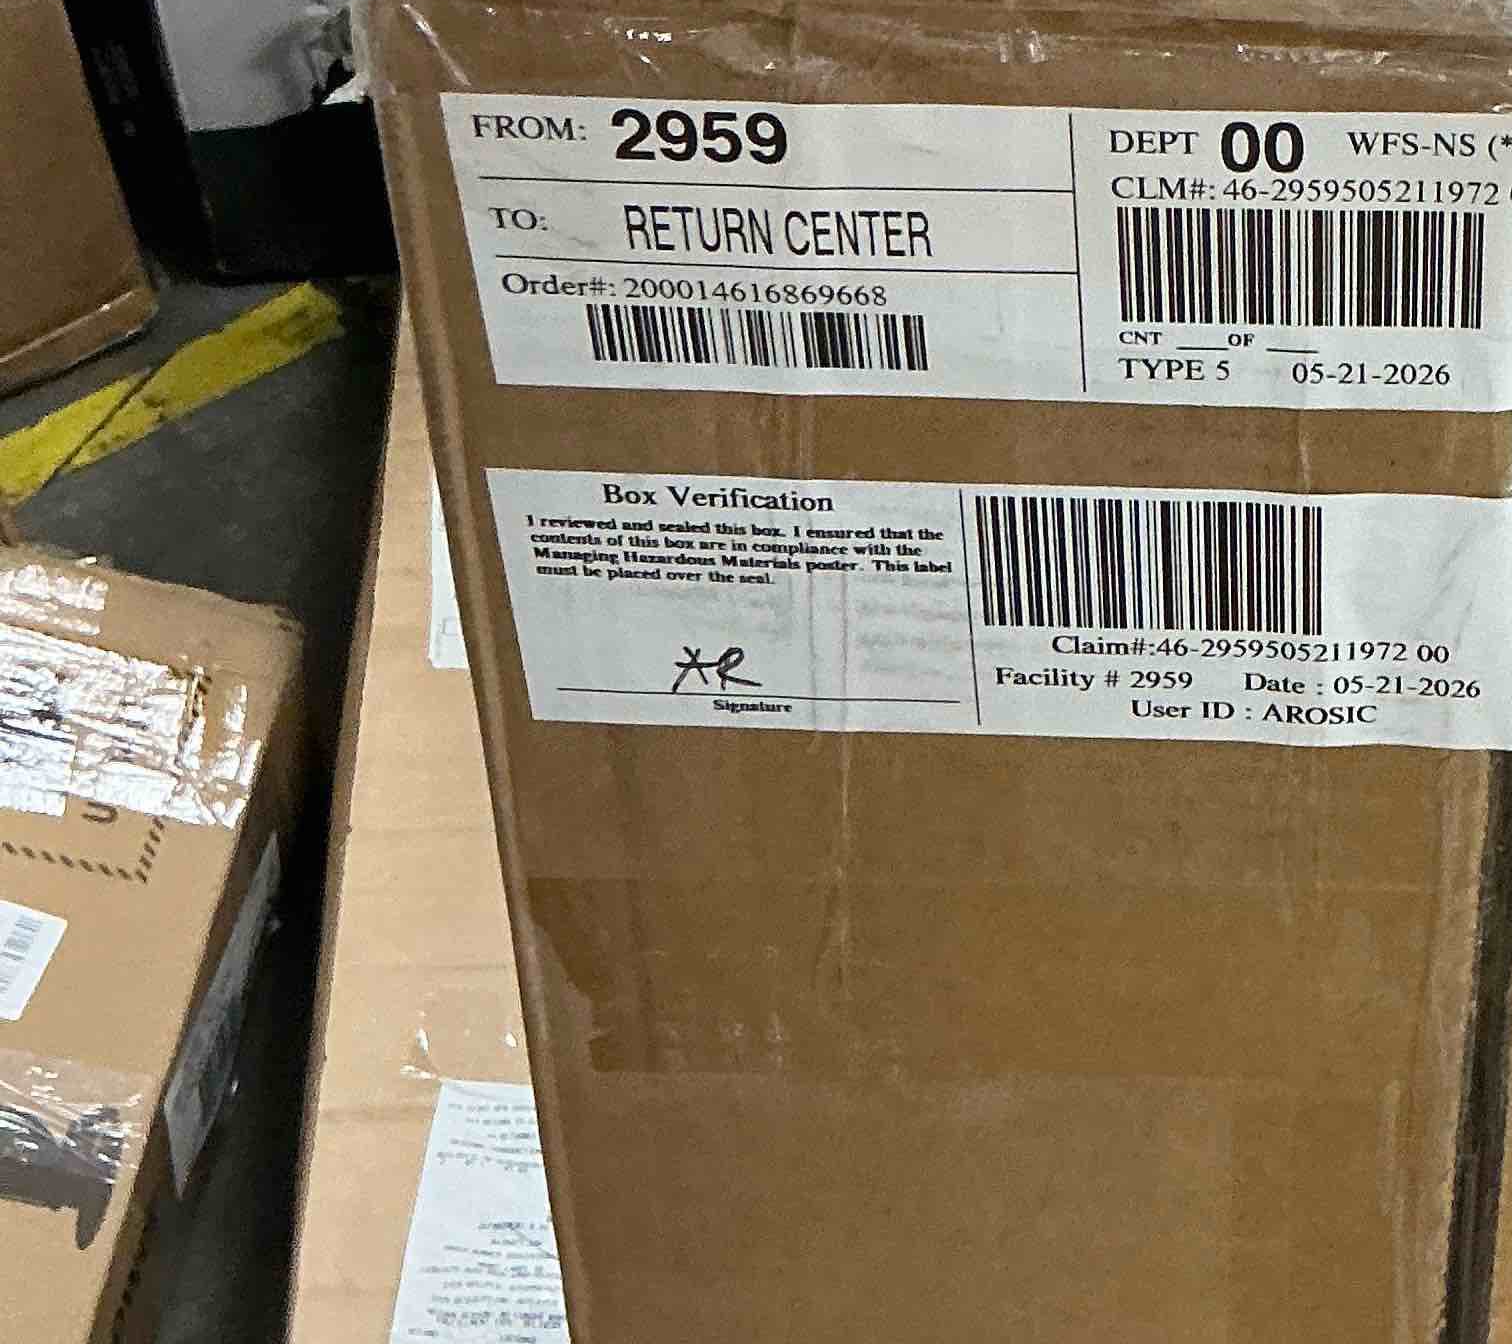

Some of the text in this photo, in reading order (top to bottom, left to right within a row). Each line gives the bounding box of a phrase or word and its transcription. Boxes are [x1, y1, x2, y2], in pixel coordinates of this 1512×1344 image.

[472, 108, 788, 165] FROM: 2959
[1109, 130, 1199, 154] DEPT
[1220, 121, 1305, 173] 00
[1347, 132, 1476, 157] WFS-NS
[1111, 176, 1216, 201] CLM#:
[488, 205, 934, 257] TO: RETURN CENTER
[1118, 331, 1255, 347] CNT OF
[1118, 358, 1450, 385] TYPE 5 05-21-2026
[603, 483, 834, 512] Box Verification
[540, 516, 617, 530] reviewed
[622, 519, 653, 531] and
[659, 520, 711, 534] sealed
[715, 523, 746, 536] this
[793, 525, 801, 538] I
[806, 526, 875, 540] ensured
[880, 527, 913, 541] that
[918, 528, 945, 541] the
[530, 533, 923, 557] contents of this box are in compliance with the
[533, 547, 619, 564] Managing
[623, 550, 716, 567] Hazardous
[722, 555, 800, 570] Materials
[872, 559, 910, 573] This
[914, 560, 953, 574] label
[536, 564, 577, 576] must
[583, 565, 602, 578] be
[607, 567, 661, 581] placed
[666, 571, 703, 582] over
[708, 570, 736, 584] the
[1416, 644, 1450, 664] 00
[995, 667, 1095, 692] Facility
[1104, 670, 1120, 688] #
[1130, 670, 1193, 689] 2959
[1244, 672, 1306, 694] Date
[1333, 675, 1481, 698] 05-21-2026
[713, 698, 793, 714] Signature
[1131, 699, 1193, 719] User
[1200, 701, 1236, 720] ID
[1261, 703, 1378, 725] AROSIC
